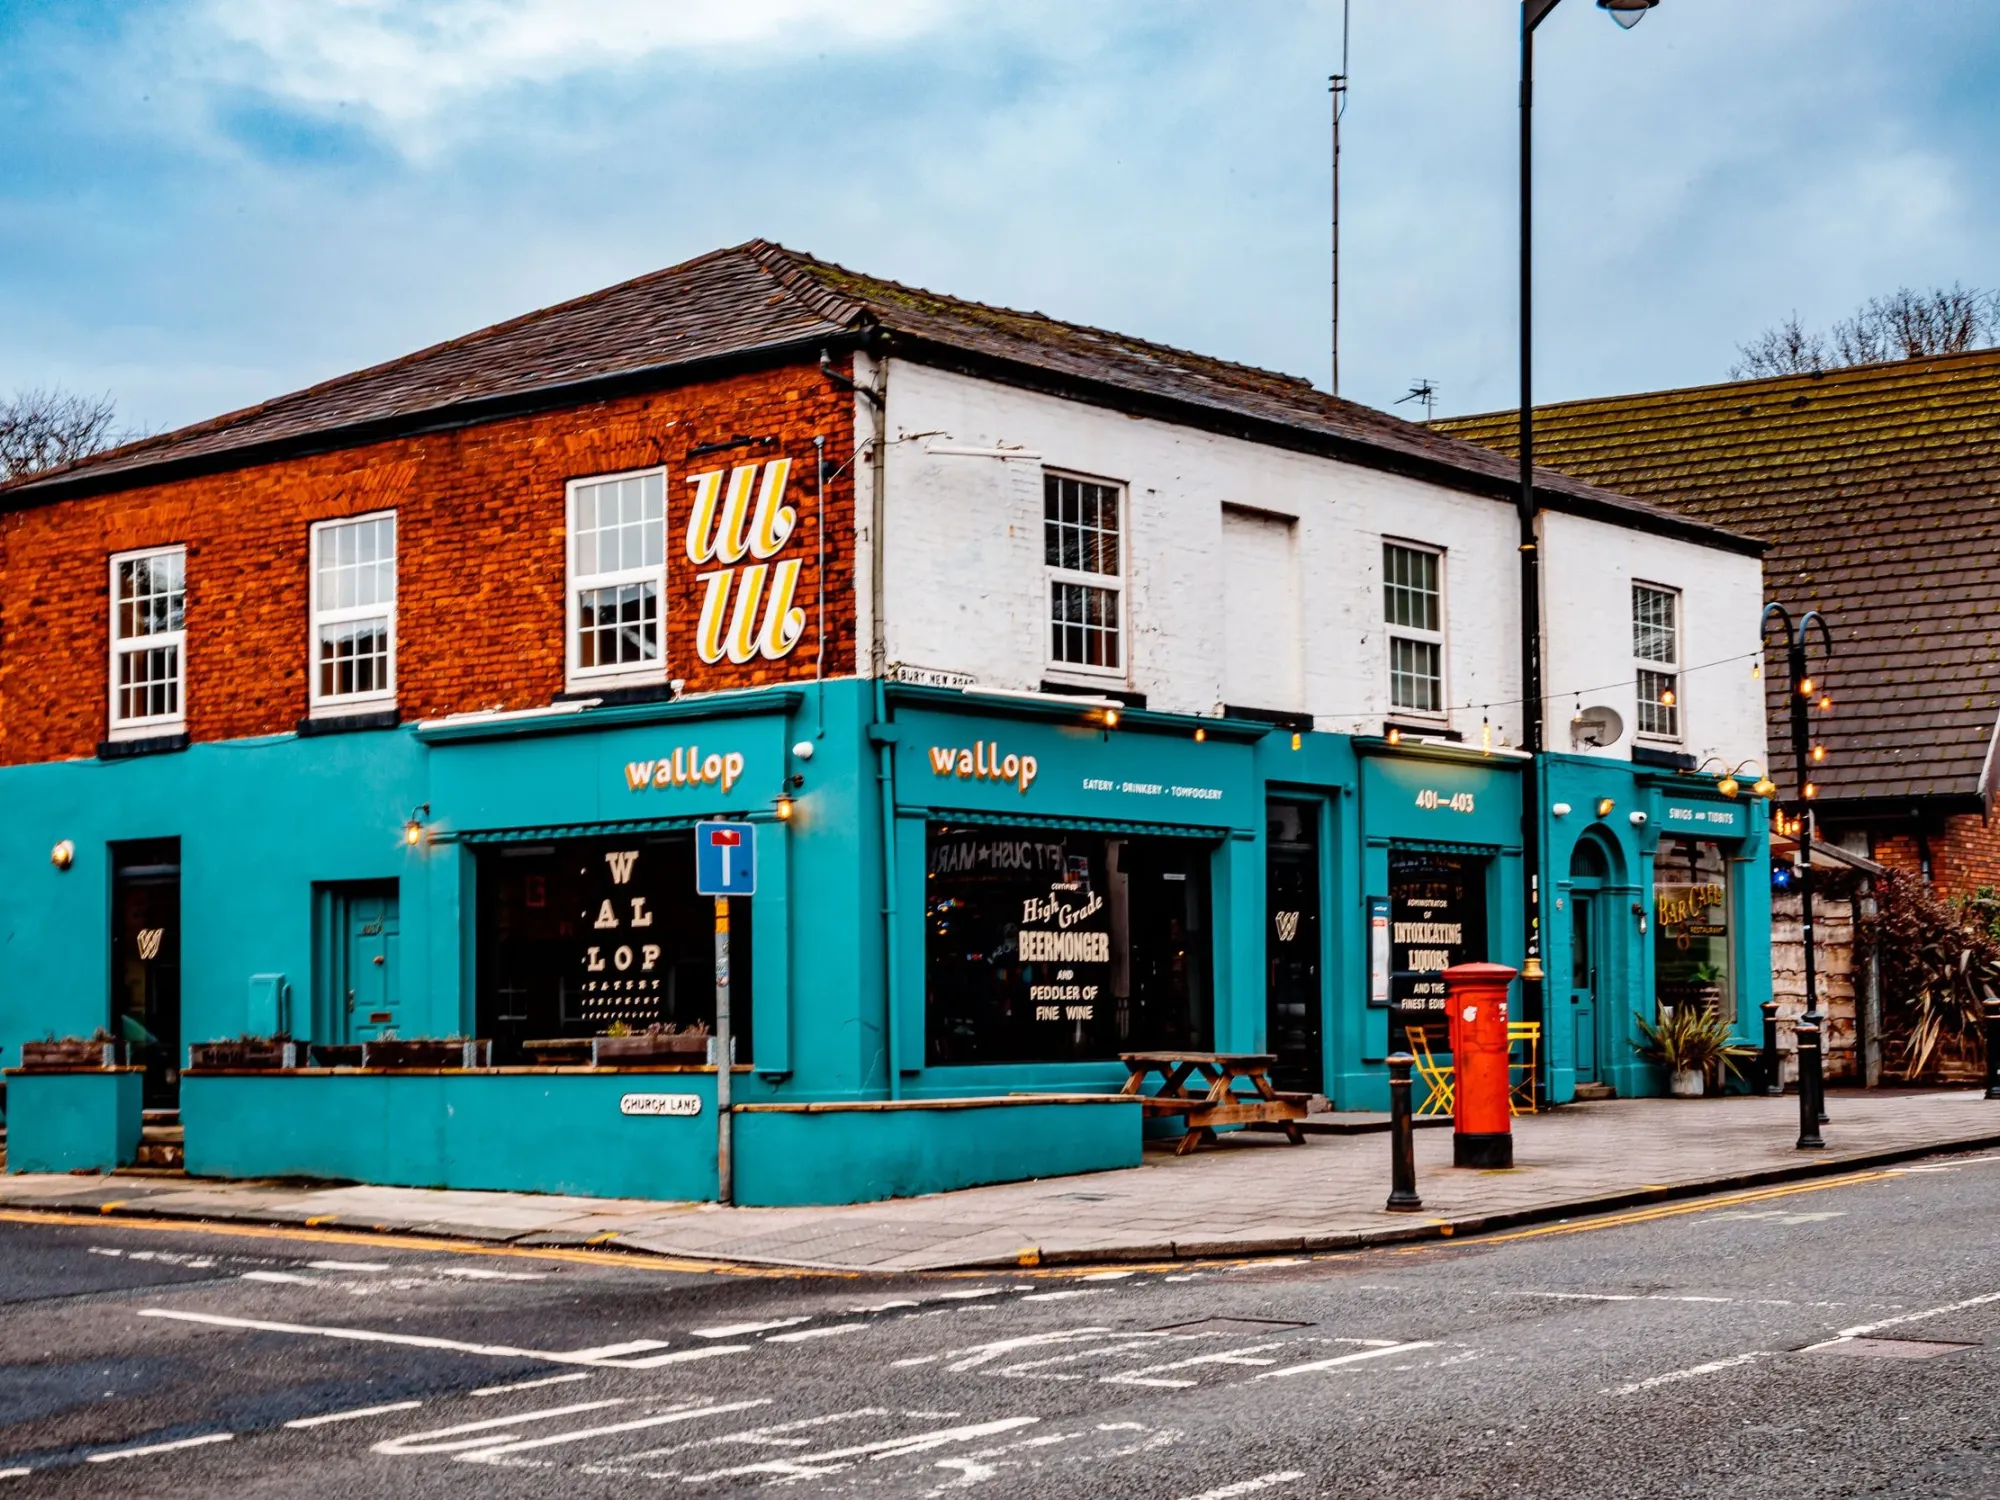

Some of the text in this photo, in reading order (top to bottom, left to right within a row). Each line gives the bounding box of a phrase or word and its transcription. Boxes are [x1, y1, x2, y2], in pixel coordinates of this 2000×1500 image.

[900, 669, 925, 682] BURY
[929, 673, 948, 685] NEW
[624, 745, 744, 794] wallop
[928, 740, 1037, 793] wallop
[1083, 779, 1223, 800] EATERY DRINKERY TOMFOOLERY
[1669, 808, 1693, 820] SWIGS
[605, 850, 640, 884] W
[1022, 891, 1103, 929] High Grade
[1423, 911, 1432, 919] OF
[1658, 892, 1688, 926] BAR
[1394, 922, 1461, 944] INTOXICATING
[1019, 930, 1109, 962] BEERMONGER
[1408, 950, 1449, 974] LIQUORS
[1056, 969, 1074, 980] AND
[1030, 985, 1098, 1000] PEDDLER OF
[1413, 983, 1445, 994] AND THE
[1036, 1005, 1093, 1020] FINE WINE
[1401, 998, 1446, 1010] FINEST EDIB
[623, 1099, 697, 1111] CHURCH LANE
